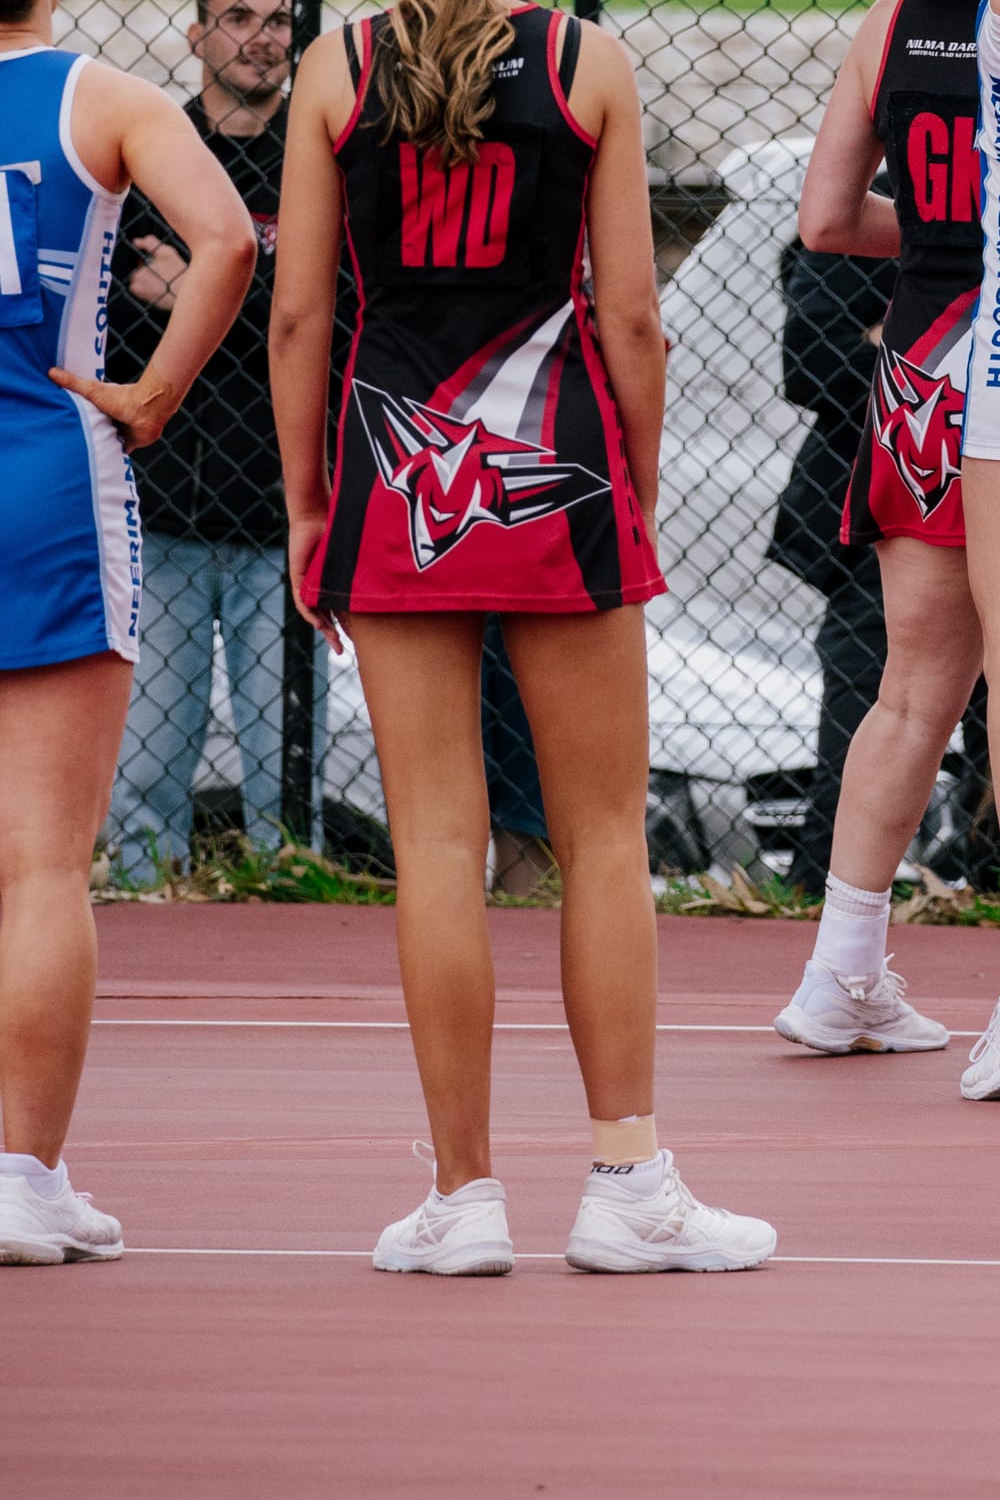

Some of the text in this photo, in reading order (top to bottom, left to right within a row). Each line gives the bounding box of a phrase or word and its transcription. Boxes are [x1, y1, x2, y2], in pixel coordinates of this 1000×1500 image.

[905, 39, 977, 52] NILMA DAR
[399, 141, 516, 268] WD
